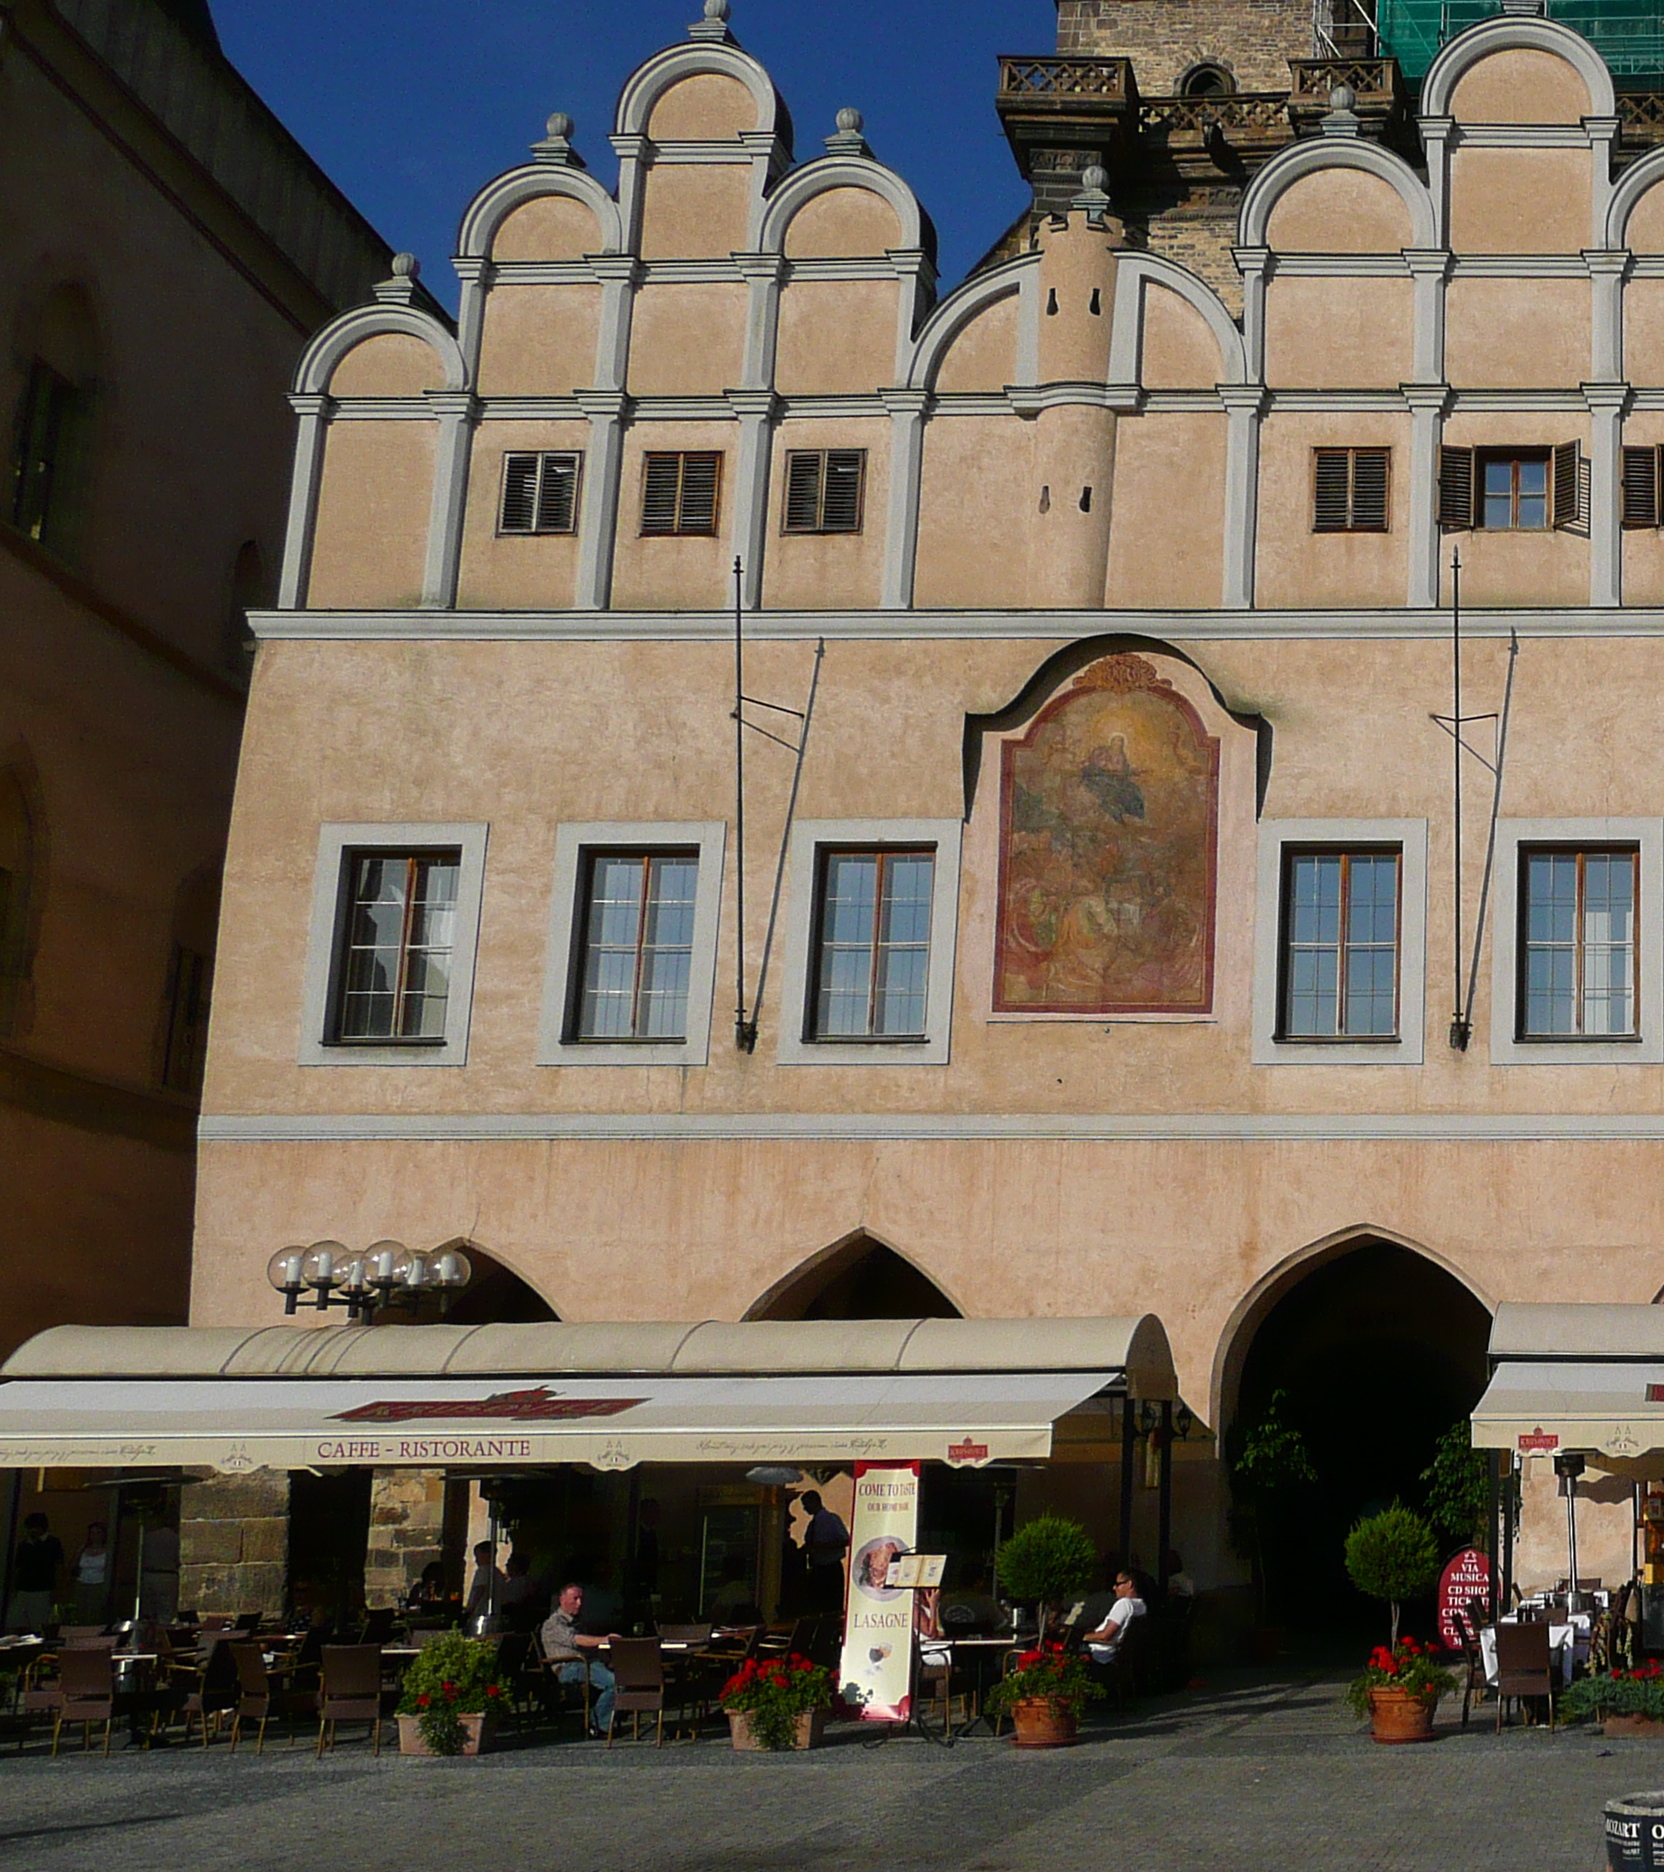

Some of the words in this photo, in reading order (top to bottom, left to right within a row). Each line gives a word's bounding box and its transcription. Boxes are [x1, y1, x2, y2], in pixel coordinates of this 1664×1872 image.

[318, 1441, 380, 1459] CAFFE
[400, 1440, 531, 1458] RISTORANTE
[858, 1483, 885, 1497] COME
[887, 1483, 899, 1497] TO
[1461, 1563, 1479, 1573] VIA
[1450, 1572, 1489, 1582] MUSICA
[1447, 1585, 1463, 1595] CD
[1464, 1585, 1489, 1596] SHO
[854, 1613, 909, 1629] LASAGNE
